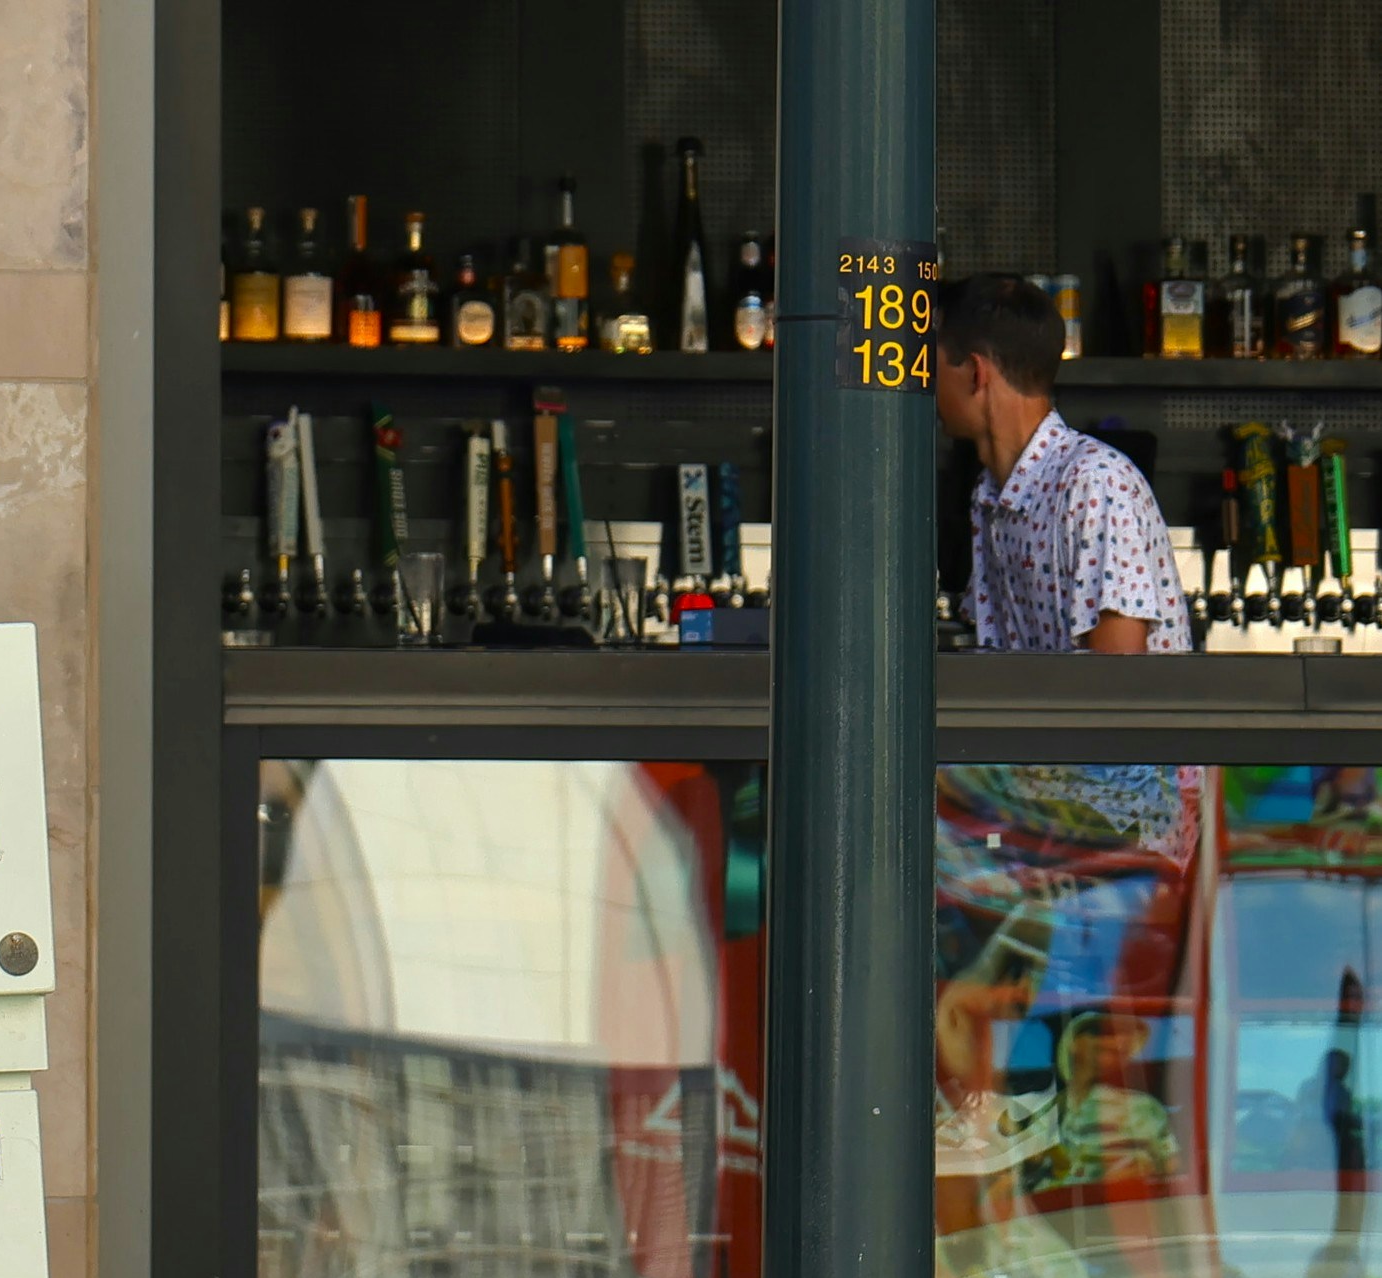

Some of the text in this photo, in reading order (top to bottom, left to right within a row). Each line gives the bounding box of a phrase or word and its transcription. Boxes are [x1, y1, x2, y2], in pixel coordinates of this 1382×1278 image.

[839, 254, 895, 274] 2143
[855, 284, 931, 334] 189
[853, 339, 930, 388] 134
[685, 495, 704, 563] Stem
